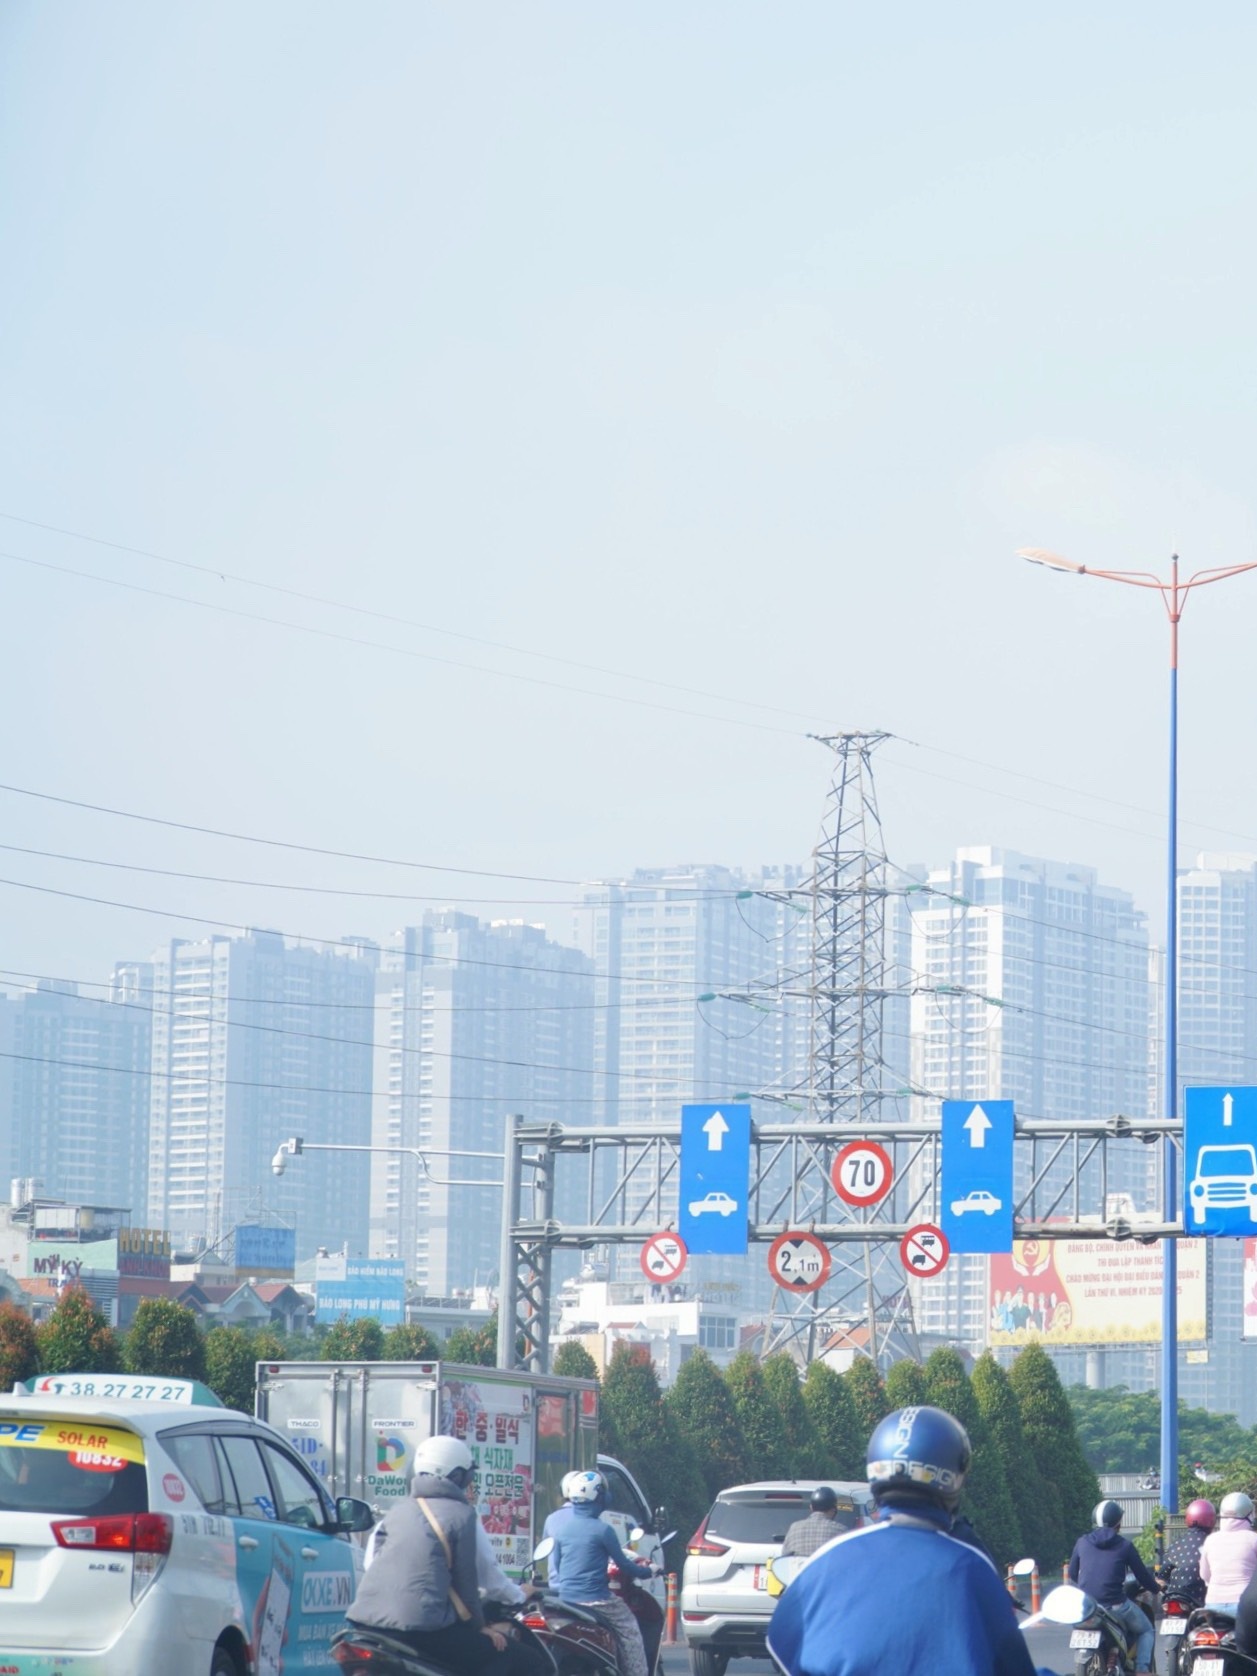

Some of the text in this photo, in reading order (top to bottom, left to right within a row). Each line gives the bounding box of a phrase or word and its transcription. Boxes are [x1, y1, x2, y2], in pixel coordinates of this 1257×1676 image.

[849, 1159, 876, 1187] 70
[119, 1227, 170, 1257] HOTEL
[132, 1384, 156, 1399] 27
[161, 1386, 185, 1400] 27
[57, 1430, 109, 1449] SOLAR
[375, 1487, 405, 1496] Food
